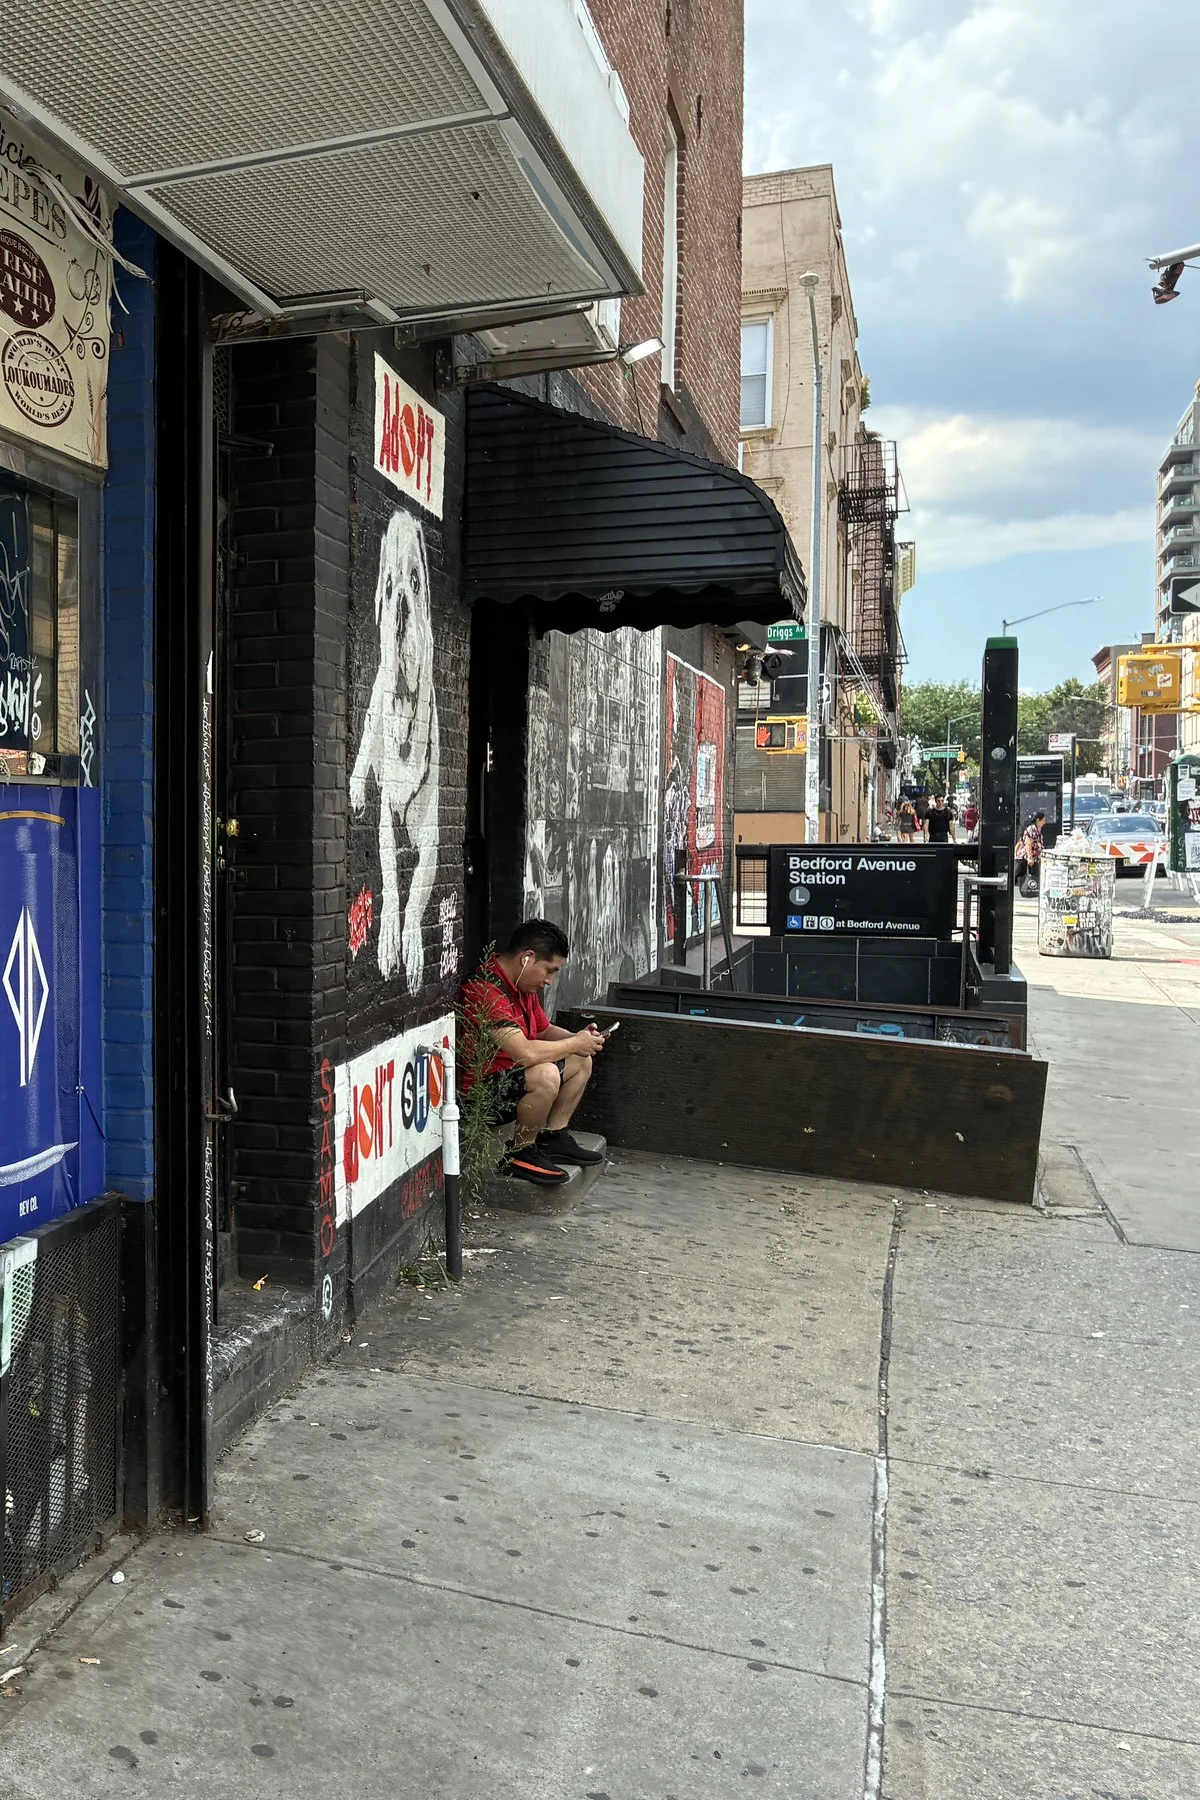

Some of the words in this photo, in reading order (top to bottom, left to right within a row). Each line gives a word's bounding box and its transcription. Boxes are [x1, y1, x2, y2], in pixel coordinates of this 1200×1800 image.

[2, 364, 75, 398] LOUKOUMADES
[768, 626, 793, 640] Driggs
[789, 857, 852, 871] Bedford
[857, 858, 917, 871] Avenue
[789, 871, 846, 885] Station
[795, 888, 806, 902] L
[836, 920, 846, 928] at
[847, 919, 884, 929] Bedford
[886, 920, 921, 931] Avenue
